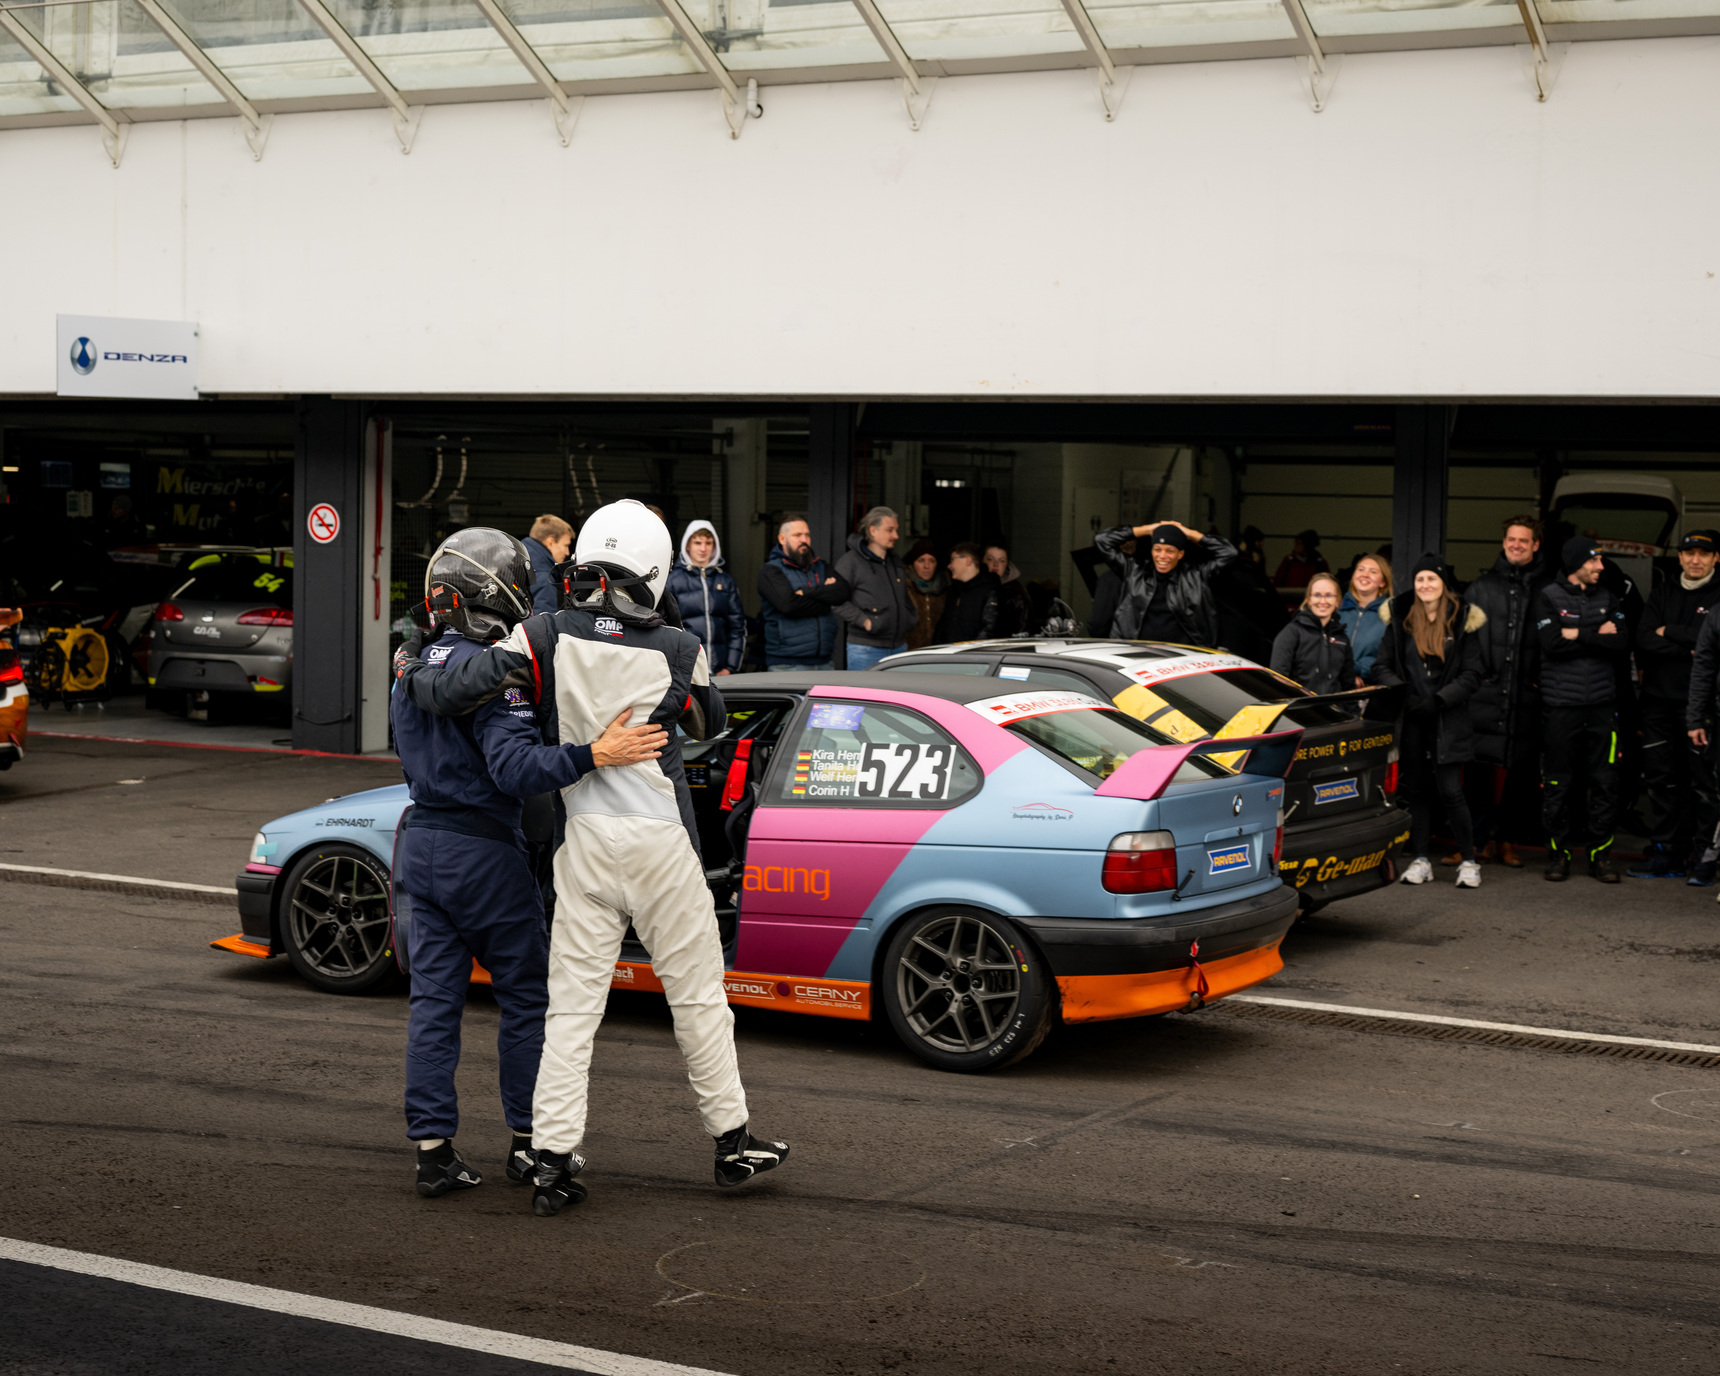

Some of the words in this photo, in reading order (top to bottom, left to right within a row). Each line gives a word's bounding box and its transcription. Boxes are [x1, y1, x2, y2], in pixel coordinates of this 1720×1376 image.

[103, 352, 188, 363] DENZA
[253, 572, 285, 593] 54
[594, 620, 624, 631] OMP
[812, 749, 835, 760] Kira
[1309, 744, 1335, 759] POWER
[1349, 740, 1362, 752] FOR
[812, 760, 844, 771] Tanita
[858, 742, 952, 799] 523
[810, 771, 836, 782] Welf
[808, 784, 838, 796] Corin
[840, 785, 850, 796] H
[1320, 784, 1354, 798] RAVENOL
[325, 818, 376, 829] EHRHARDT
[1213, 852, 1247, 867] RAVENOL
[1316, 849, 1386, 882] Ge-man
[742, 865, 830, 901] acing
[794, 985, 862, 1001] CERNY
[795, 998, 863, 1010] AUTOMOBILSERVICE
